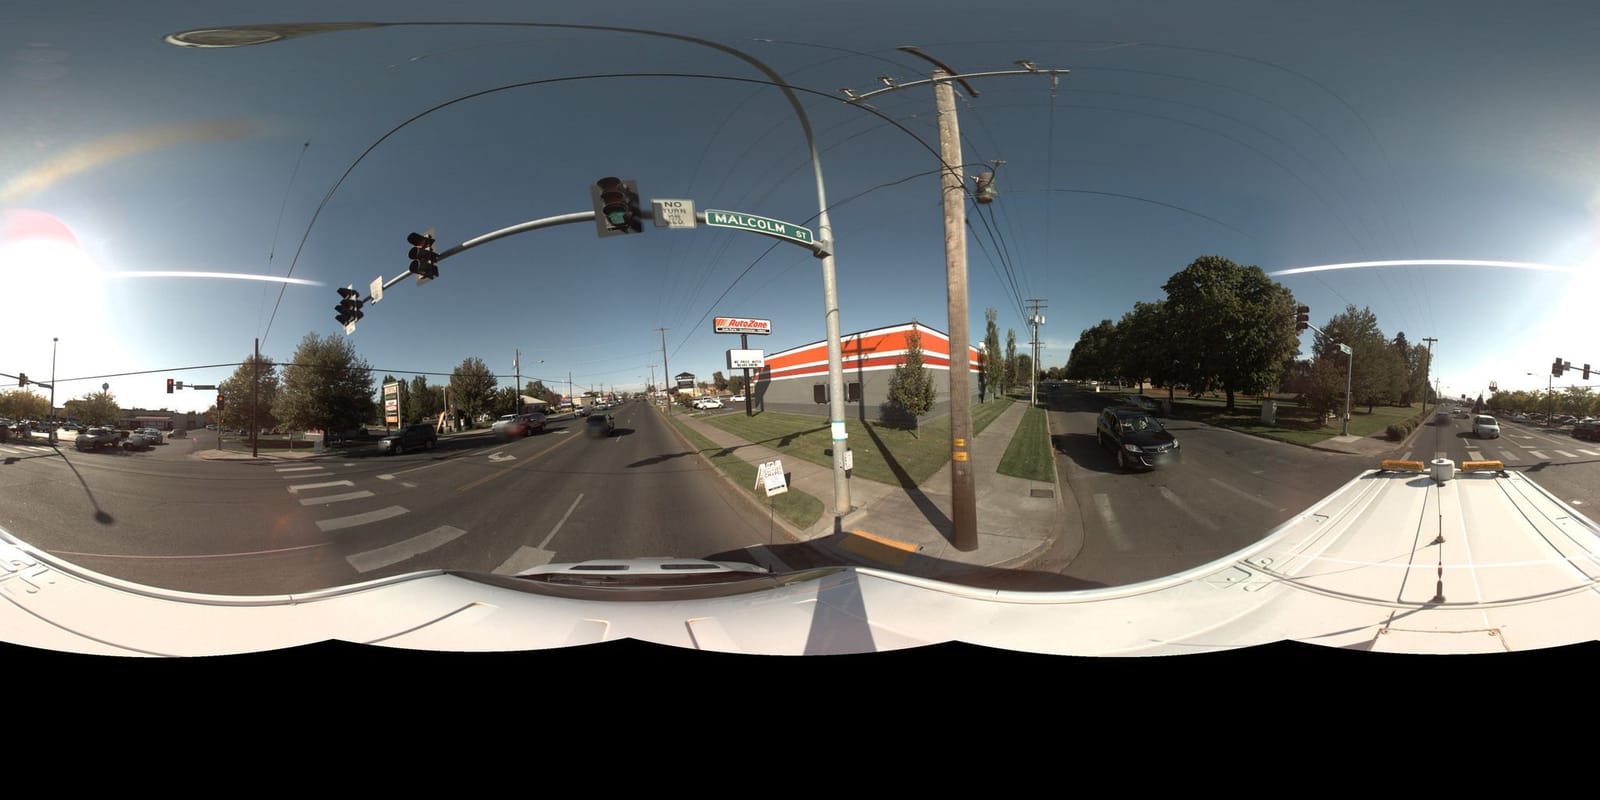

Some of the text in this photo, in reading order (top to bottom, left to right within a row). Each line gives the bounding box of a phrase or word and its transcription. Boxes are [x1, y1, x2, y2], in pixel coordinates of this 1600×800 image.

[715, 213, 807, 240] MALCOLM ST
[729, 319, 768, 329] AutoZone
